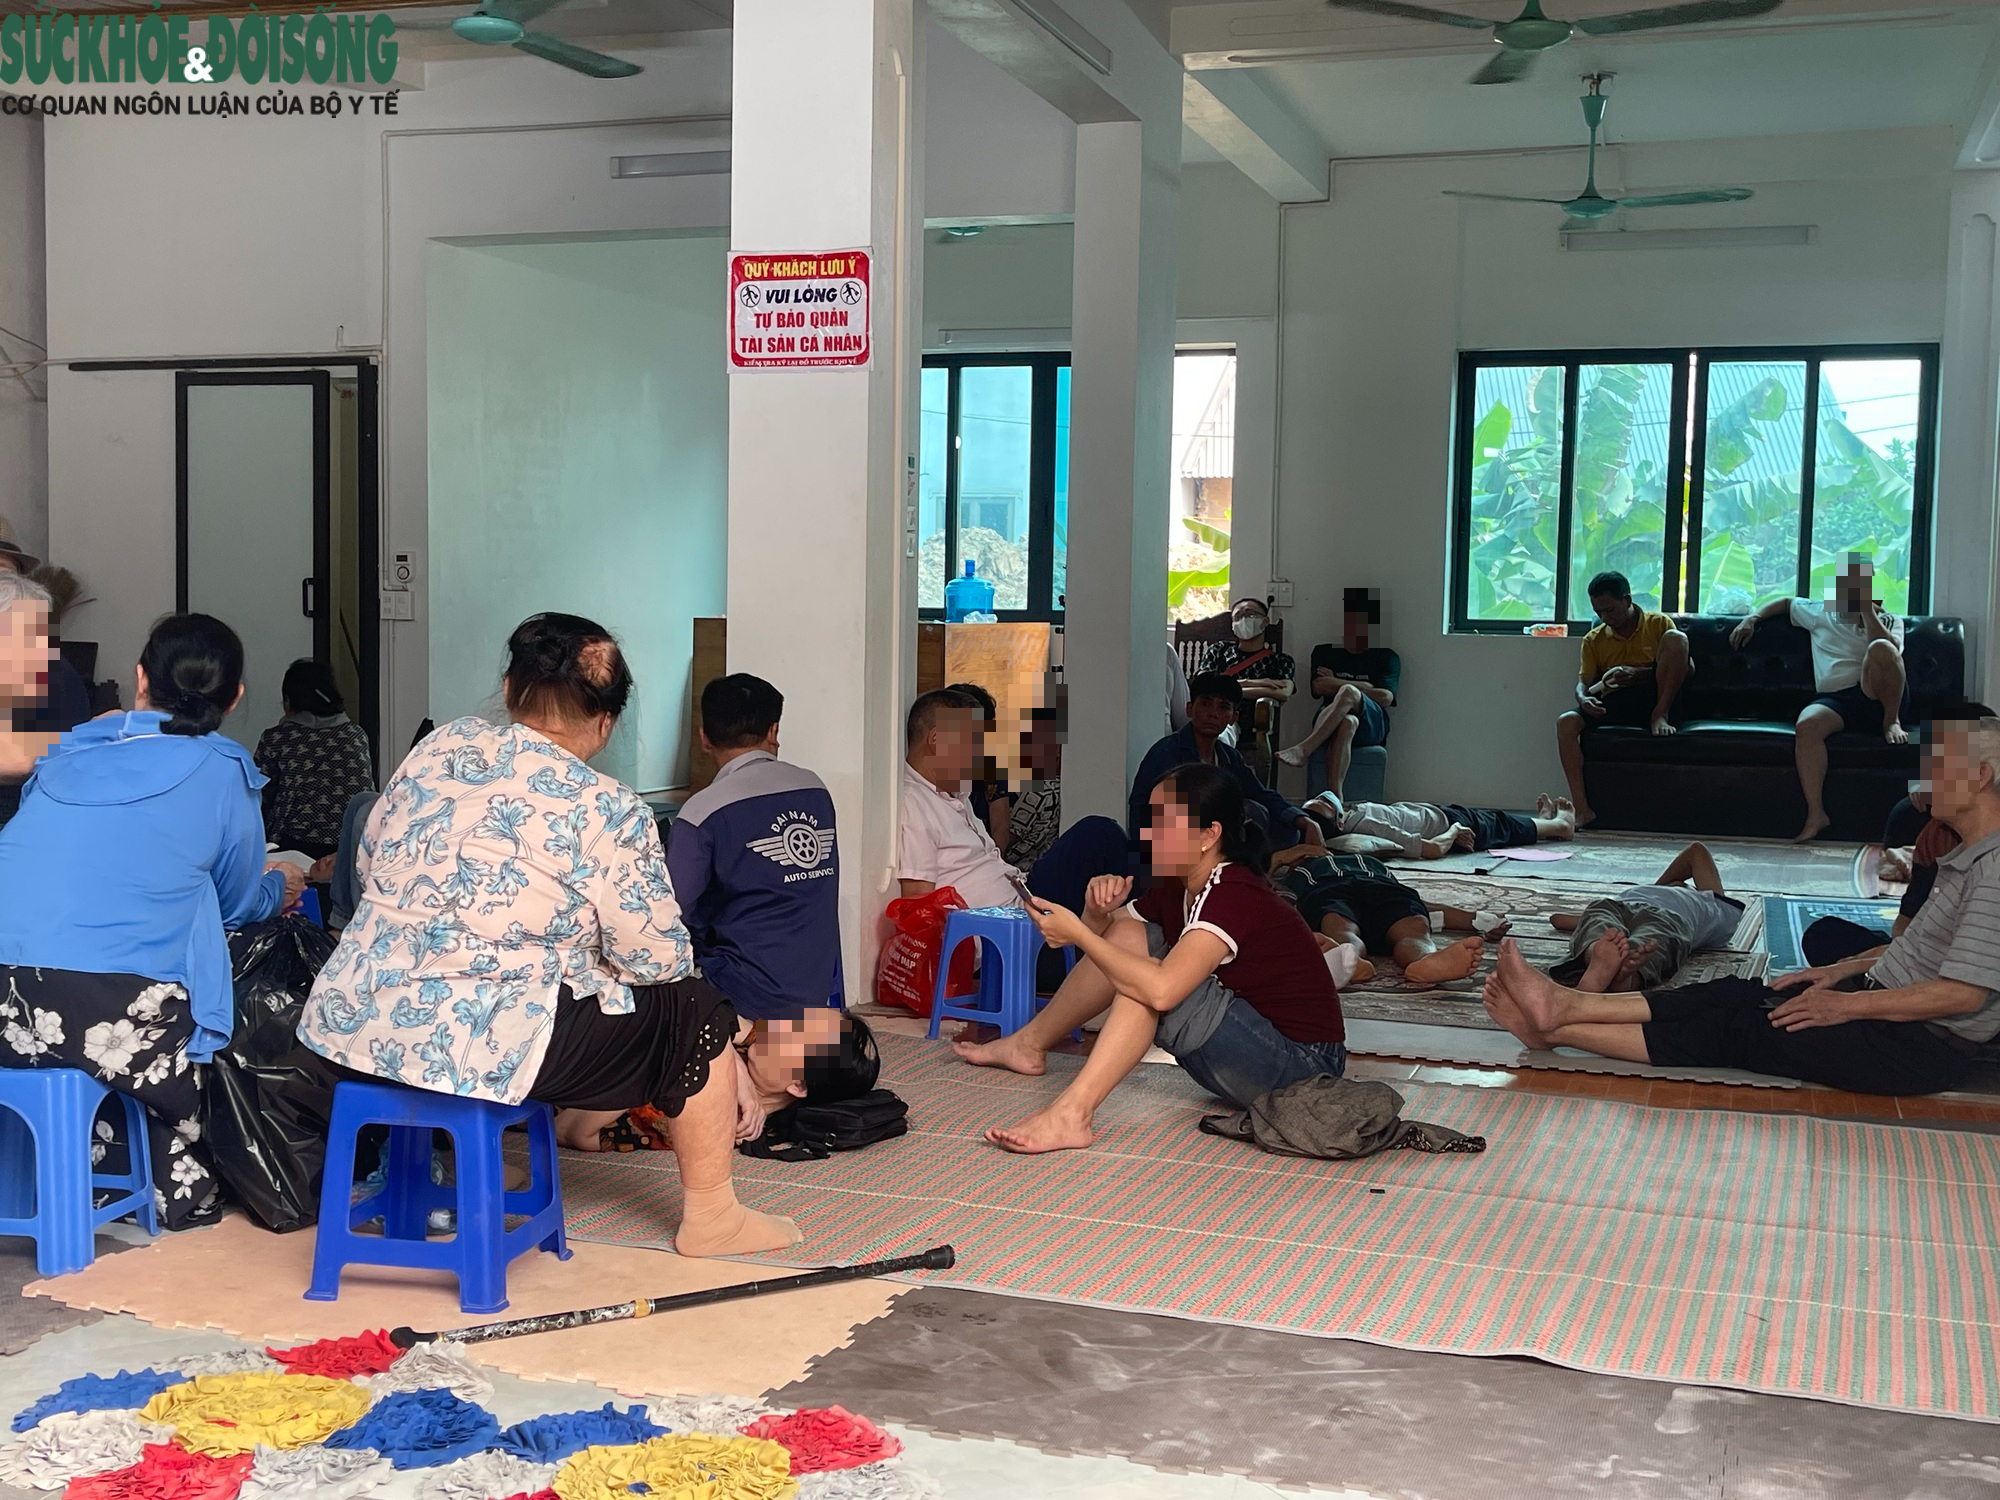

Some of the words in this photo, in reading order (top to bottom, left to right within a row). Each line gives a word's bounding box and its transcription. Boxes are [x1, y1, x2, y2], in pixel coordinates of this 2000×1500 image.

[744, 259, 770, 279] QUÝ
[773, 257, 817, 277] KHÁCH
[820, 259, 845, 276] LƯU
[848, 256, 857, 274] Ý
[766, 289, 790, 304] VUI
[754, 311, 773, 331] TỰ
[776, 309, 805, 328] BẢO
[810, 307, 848, 329] QUẢN
[740, 334, 762, 353] TÀI
[767, 333, 795, 353] SẢN
[800, 333, 819, 352] CÁ
[823, 333, 862, 351] NHÂN
[771, 813, 788, 833] ĐẠI
[789, 810, 818, 828] NAM
[783, 872, 807, 883] AUTO
